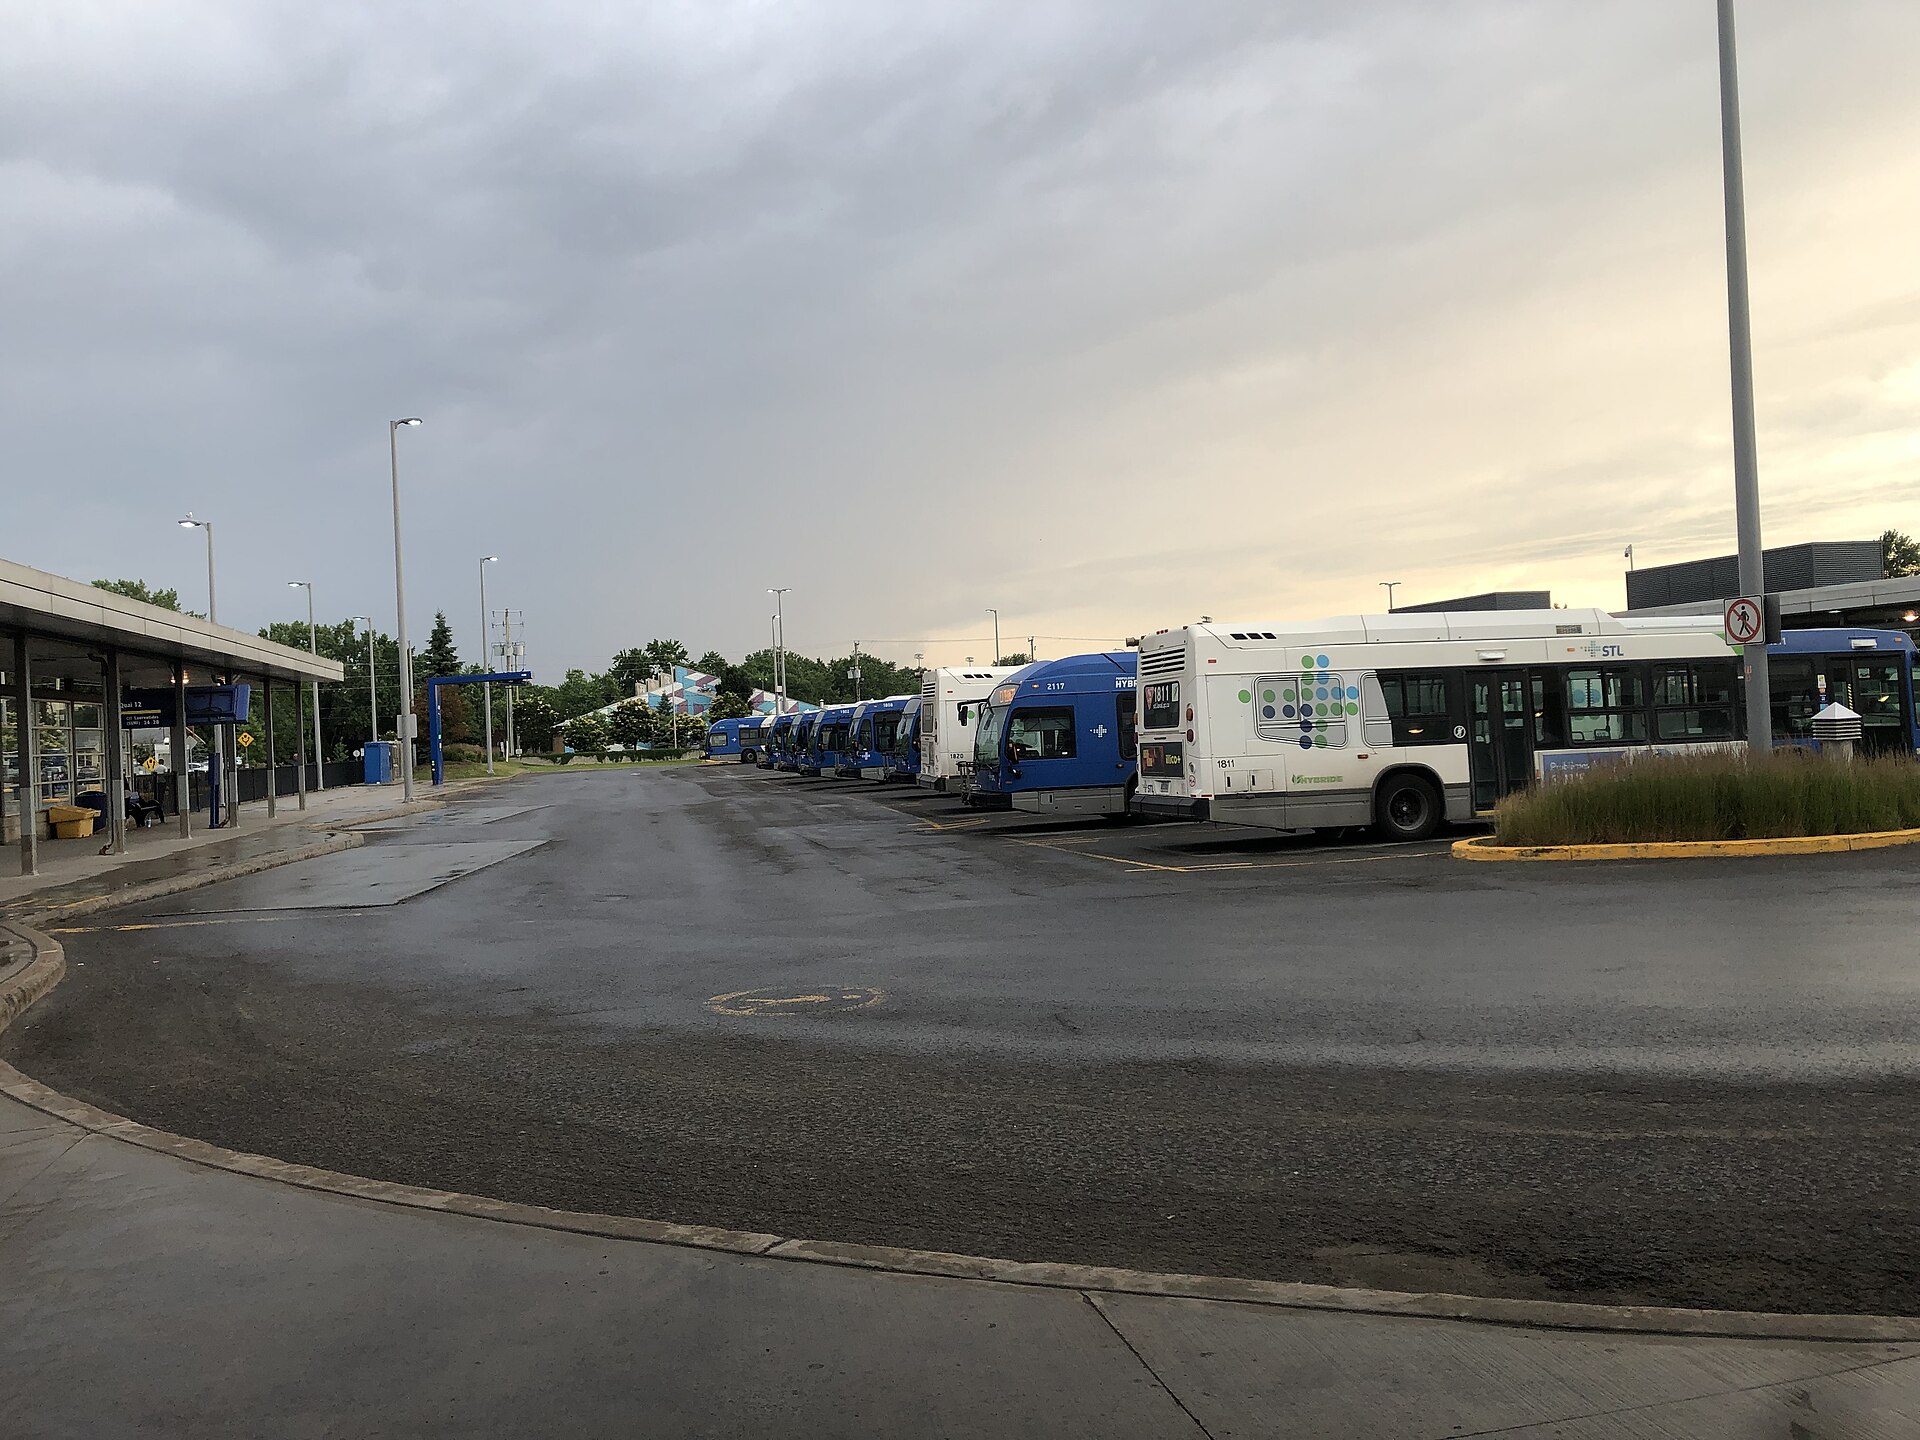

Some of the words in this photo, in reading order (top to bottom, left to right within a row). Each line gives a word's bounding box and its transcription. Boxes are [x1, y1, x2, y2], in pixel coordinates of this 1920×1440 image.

[1602, 645, 1624, 657] STL
[1154, 685, 1169, 702] 1811
[1217, 760, 1235, 768] 1811
[1299, 775, 1343, 784] HYBRIDE
